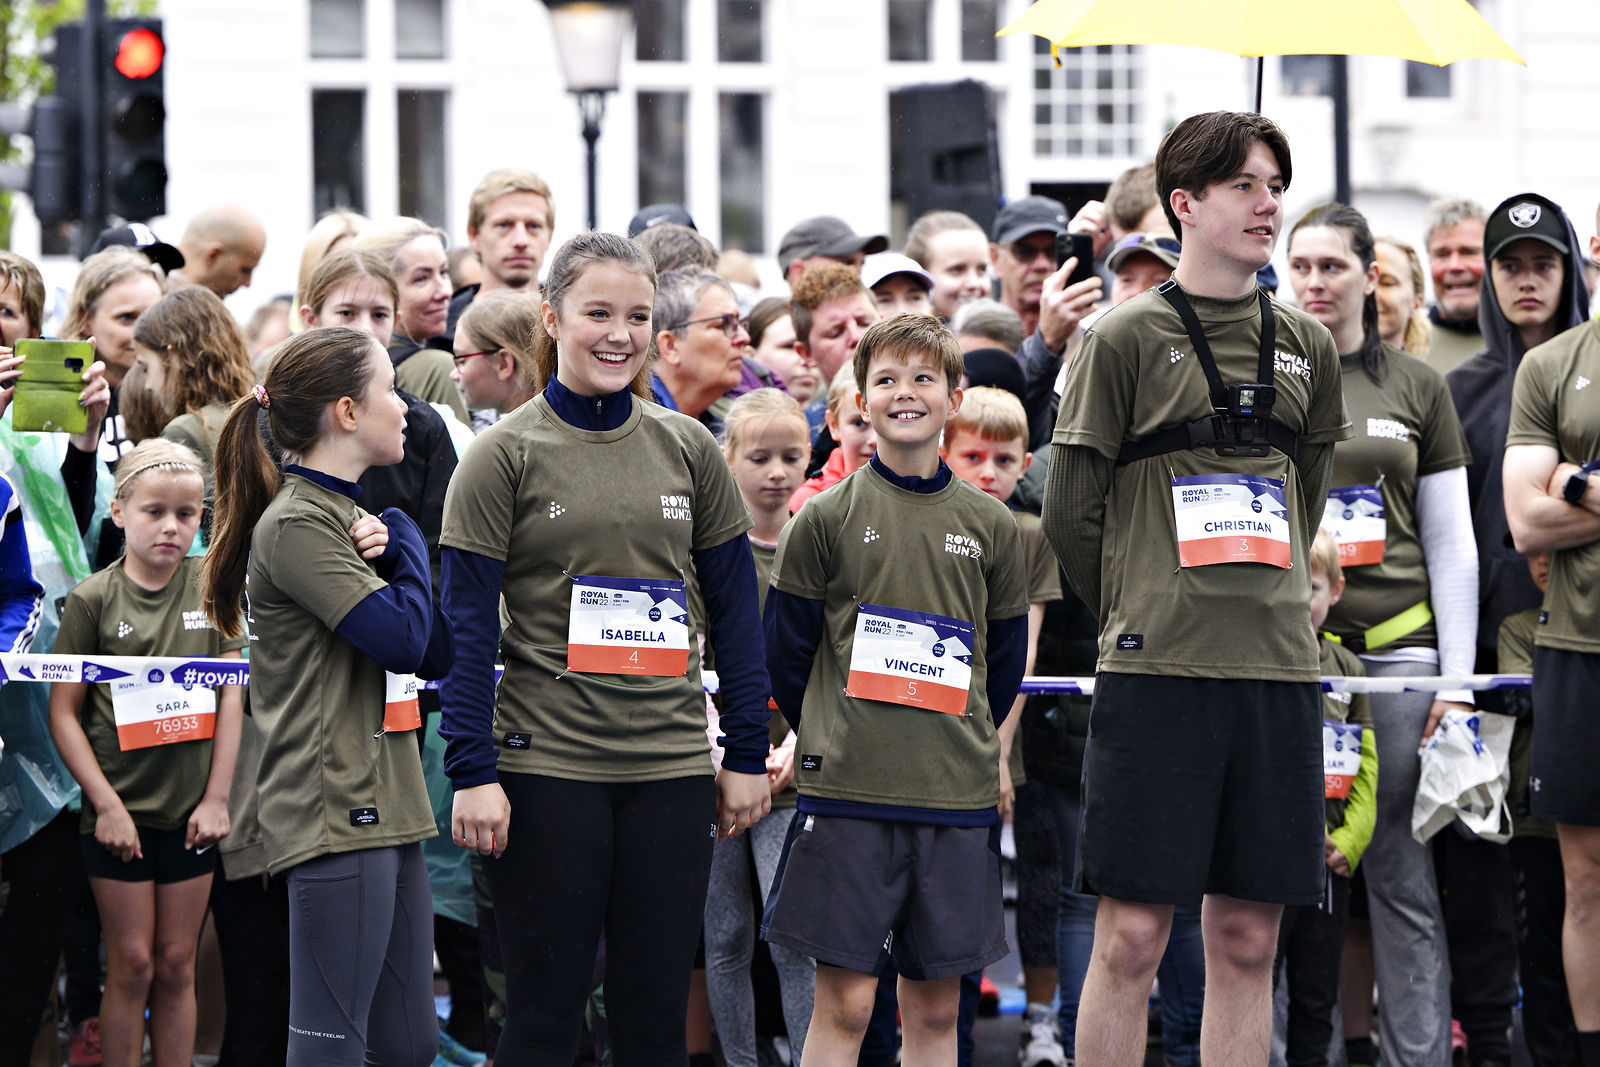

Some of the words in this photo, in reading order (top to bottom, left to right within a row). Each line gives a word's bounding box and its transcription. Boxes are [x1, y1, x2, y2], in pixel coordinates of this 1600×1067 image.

[1182, 488, 1209, 497] ROYAL
[1204, 520, 1272, 533] CHRISTIAN
[945, 533, 982, 551] ROYAL
[1239, 538, 1249, 551] 3
[580, 590, 609, 599] ROYAL
[865, 619, 892, 628] ROYAL
[601, 628, 666, 643] ISABELLA
[628, 650, 639, 664] 4
[42, 664, 74, 672] ROYAL
[885, 657, 945, 678] VINCENT
[41, 672, 62, 680] RUN
[906, 681, 918, 696] 5
[156, 700, 190, 713] SARA
[153, 716, 198, 734] 76933
[1325, 760, 1344, 768] IAM
